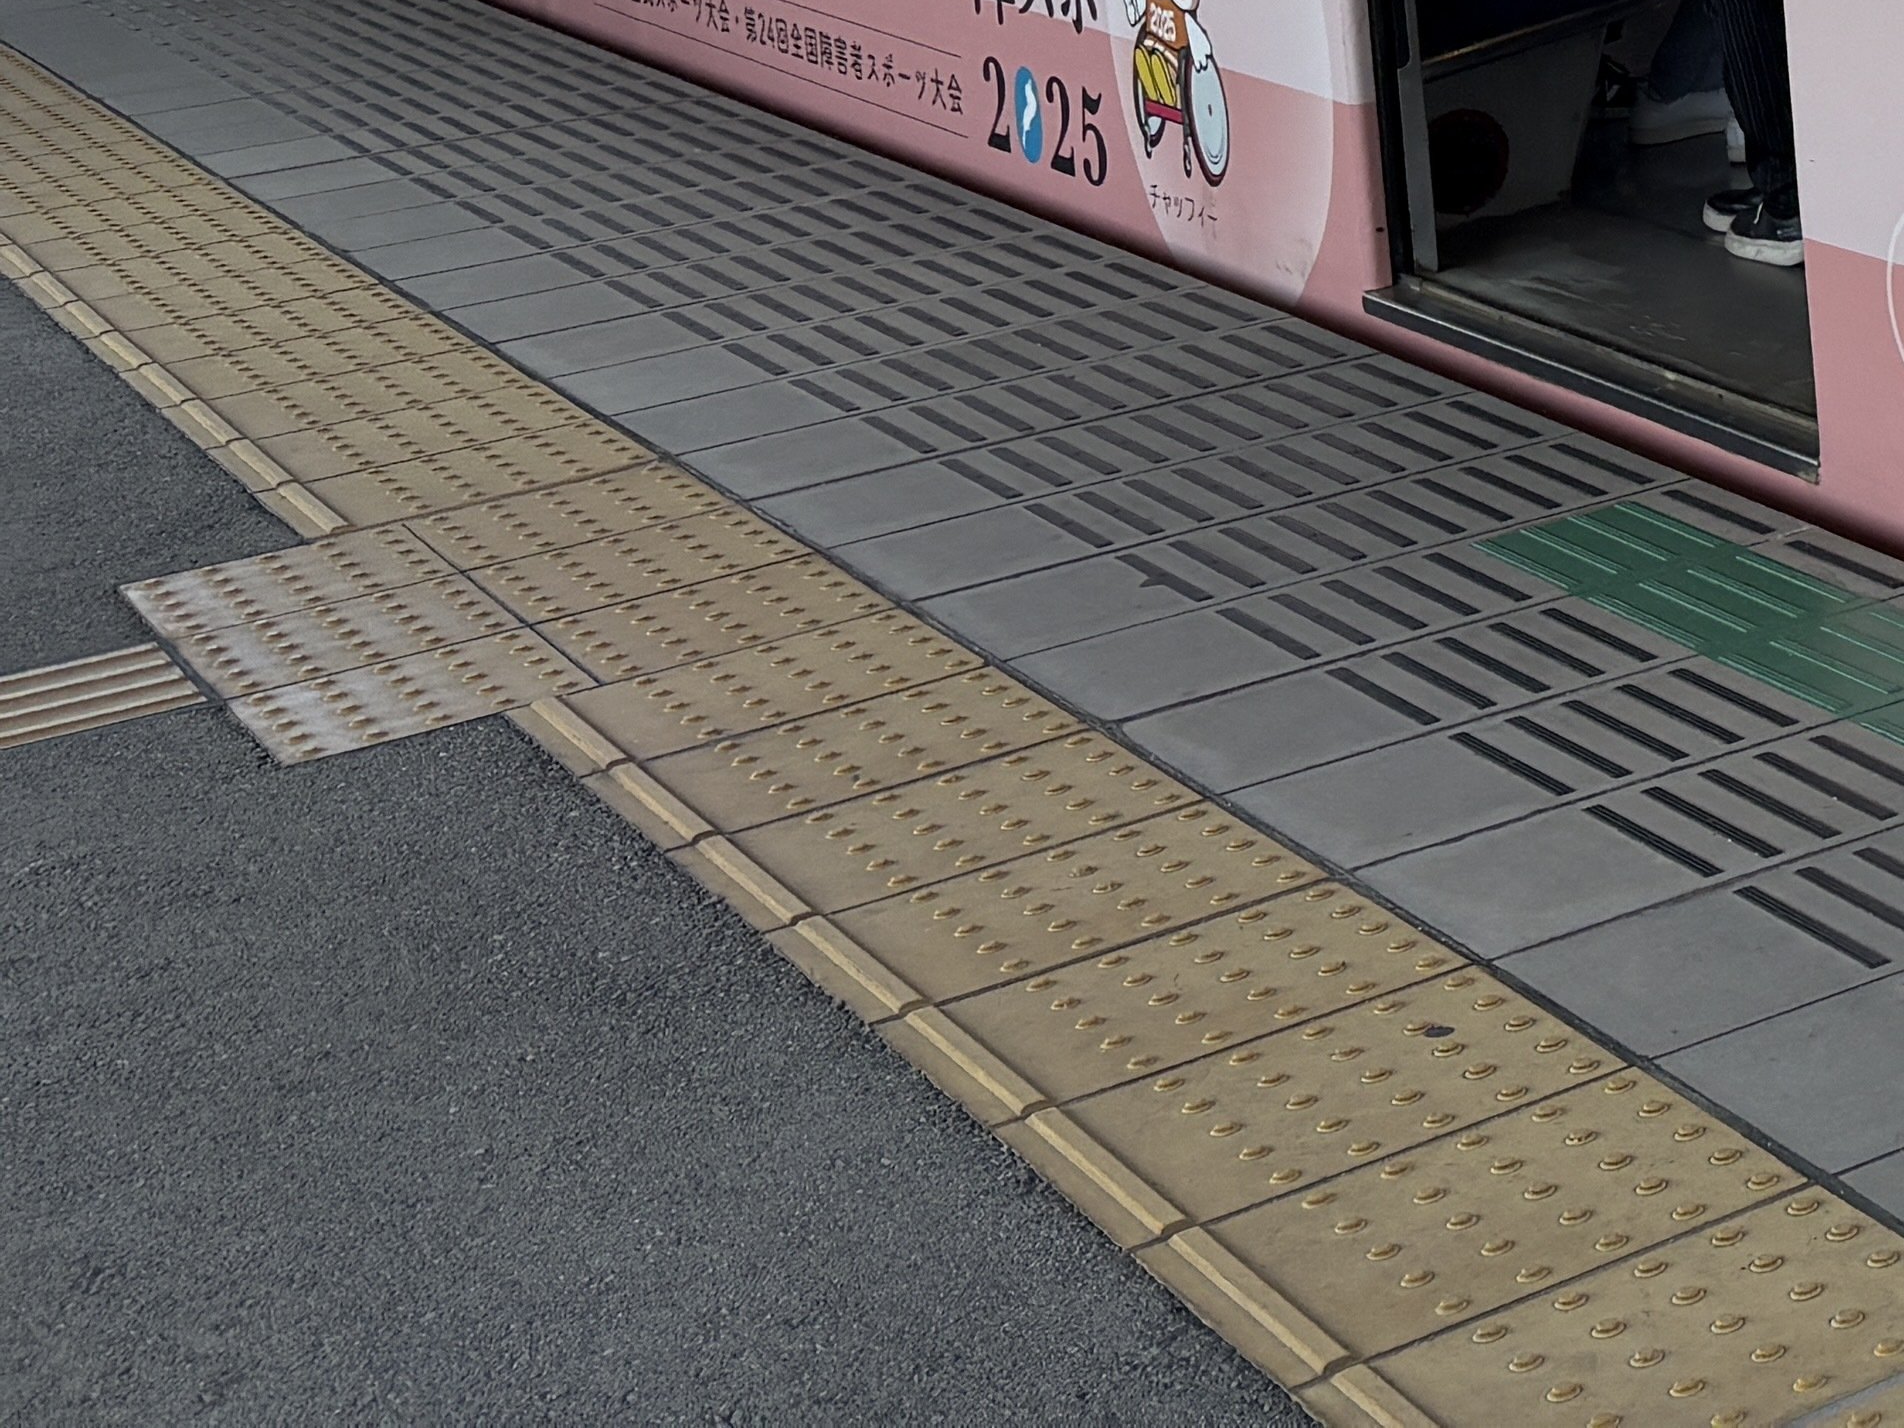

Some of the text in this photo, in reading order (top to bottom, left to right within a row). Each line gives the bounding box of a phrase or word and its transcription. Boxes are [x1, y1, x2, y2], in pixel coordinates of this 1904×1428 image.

[982, 56, 1107, 186] 2025
[1149, 185, 1217, 227] チャッフィー
